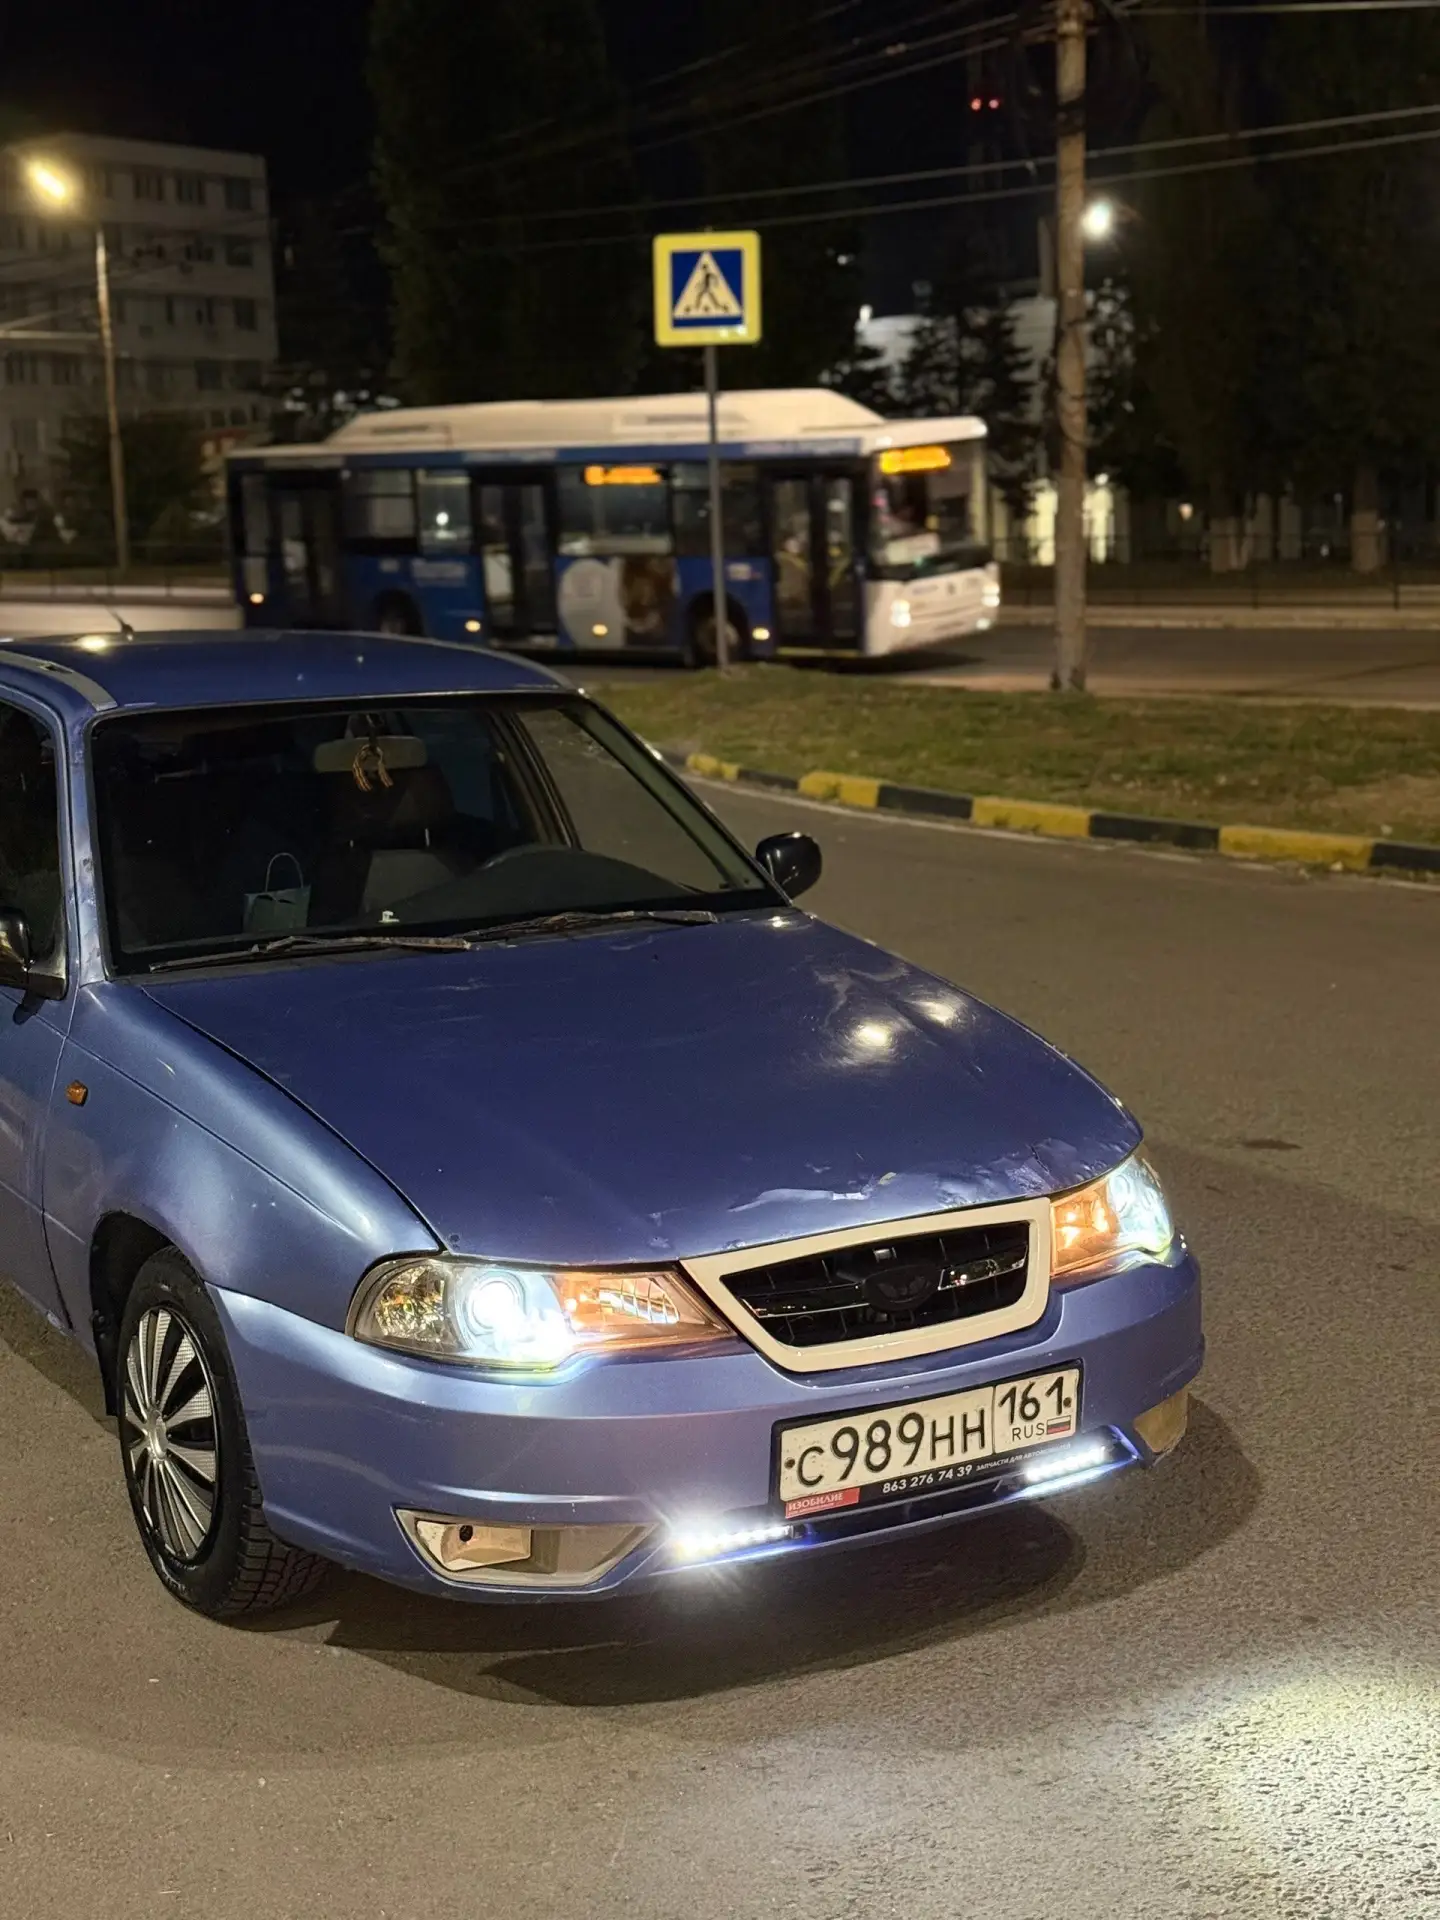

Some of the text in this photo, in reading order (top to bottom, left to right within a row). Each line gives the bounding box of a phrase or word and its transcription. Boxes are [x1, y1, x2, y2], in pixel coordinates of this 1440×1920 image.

[796, 1375, 1065, 1487] С989НН 161
[1011, 1423, 1046, 1442] RUS
[975, 1457, 1010, 1471] ЗАПЧАСТИ
[1023, 1442, 1072, 1459] АВТОЛЕЙ
[882, 1464, 974, 1494] 863 276 74 39
[787, 1492, 845, 1512] ИЗОБИЛИЕ
